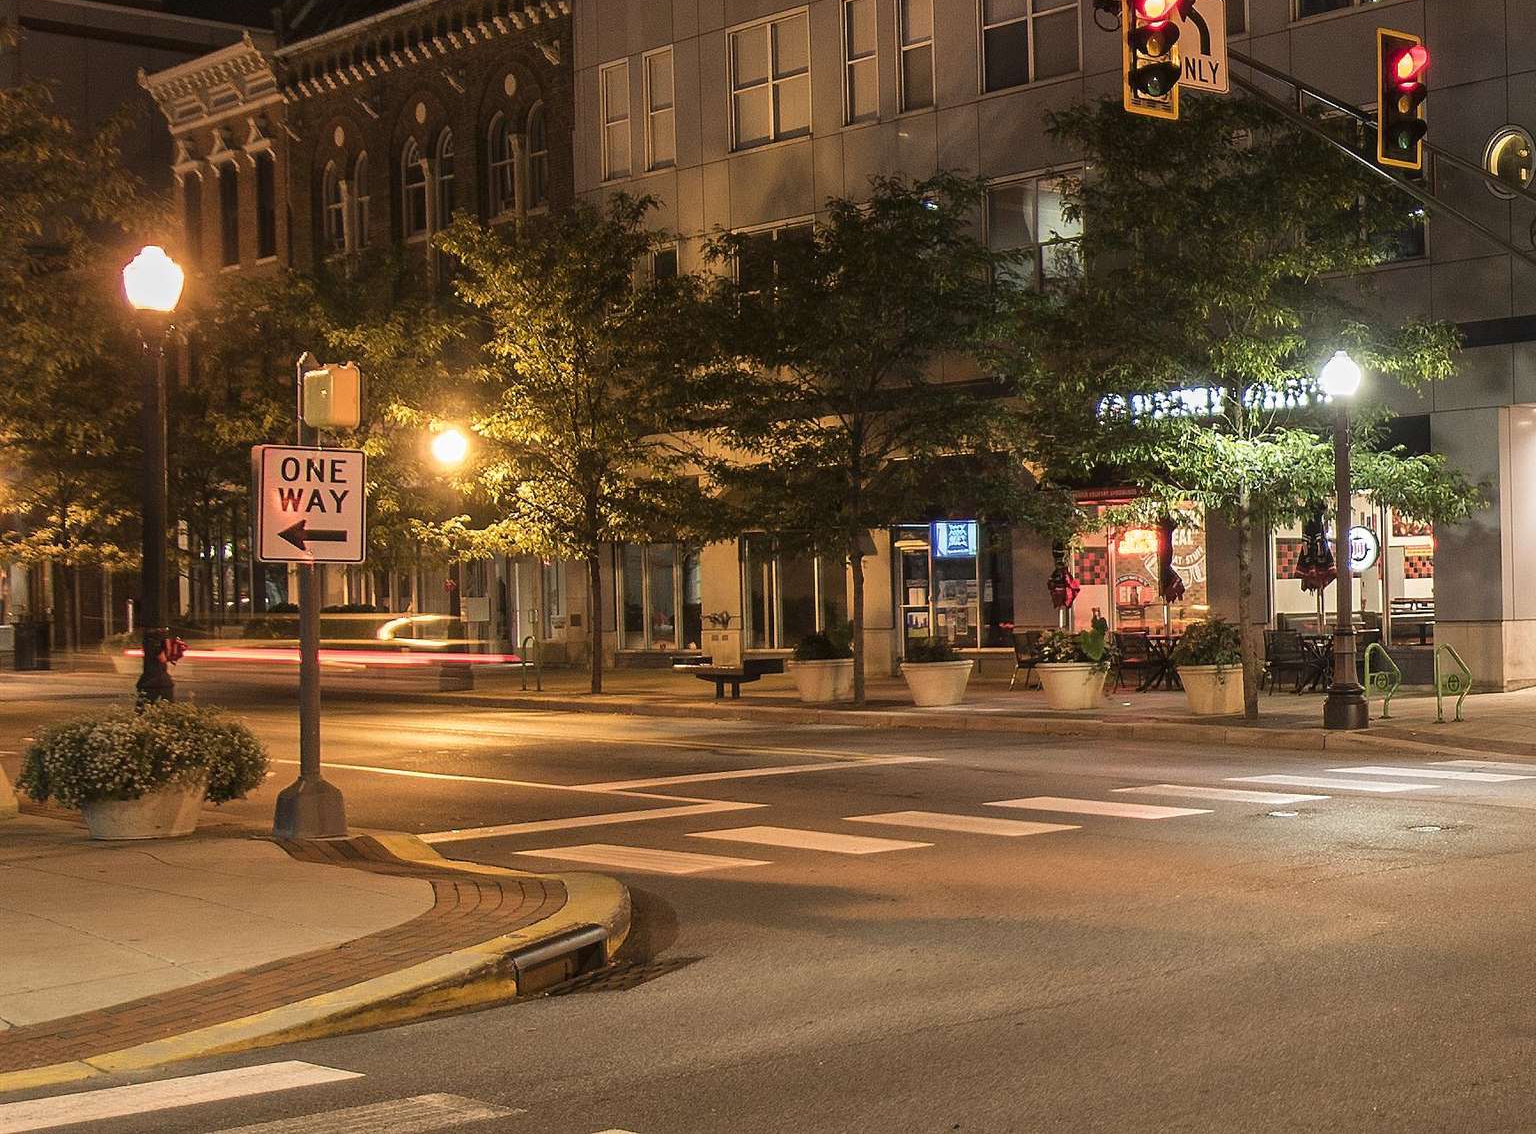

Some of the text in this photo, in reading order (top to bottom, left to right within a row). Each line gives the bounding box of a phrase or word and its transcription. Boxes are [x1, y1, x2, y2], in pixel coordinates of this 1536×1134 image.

[1180, 56, 1219, 84] NLY
[281, 456, 347, 483] ONE
[278, 487, 350, 513] WAY
